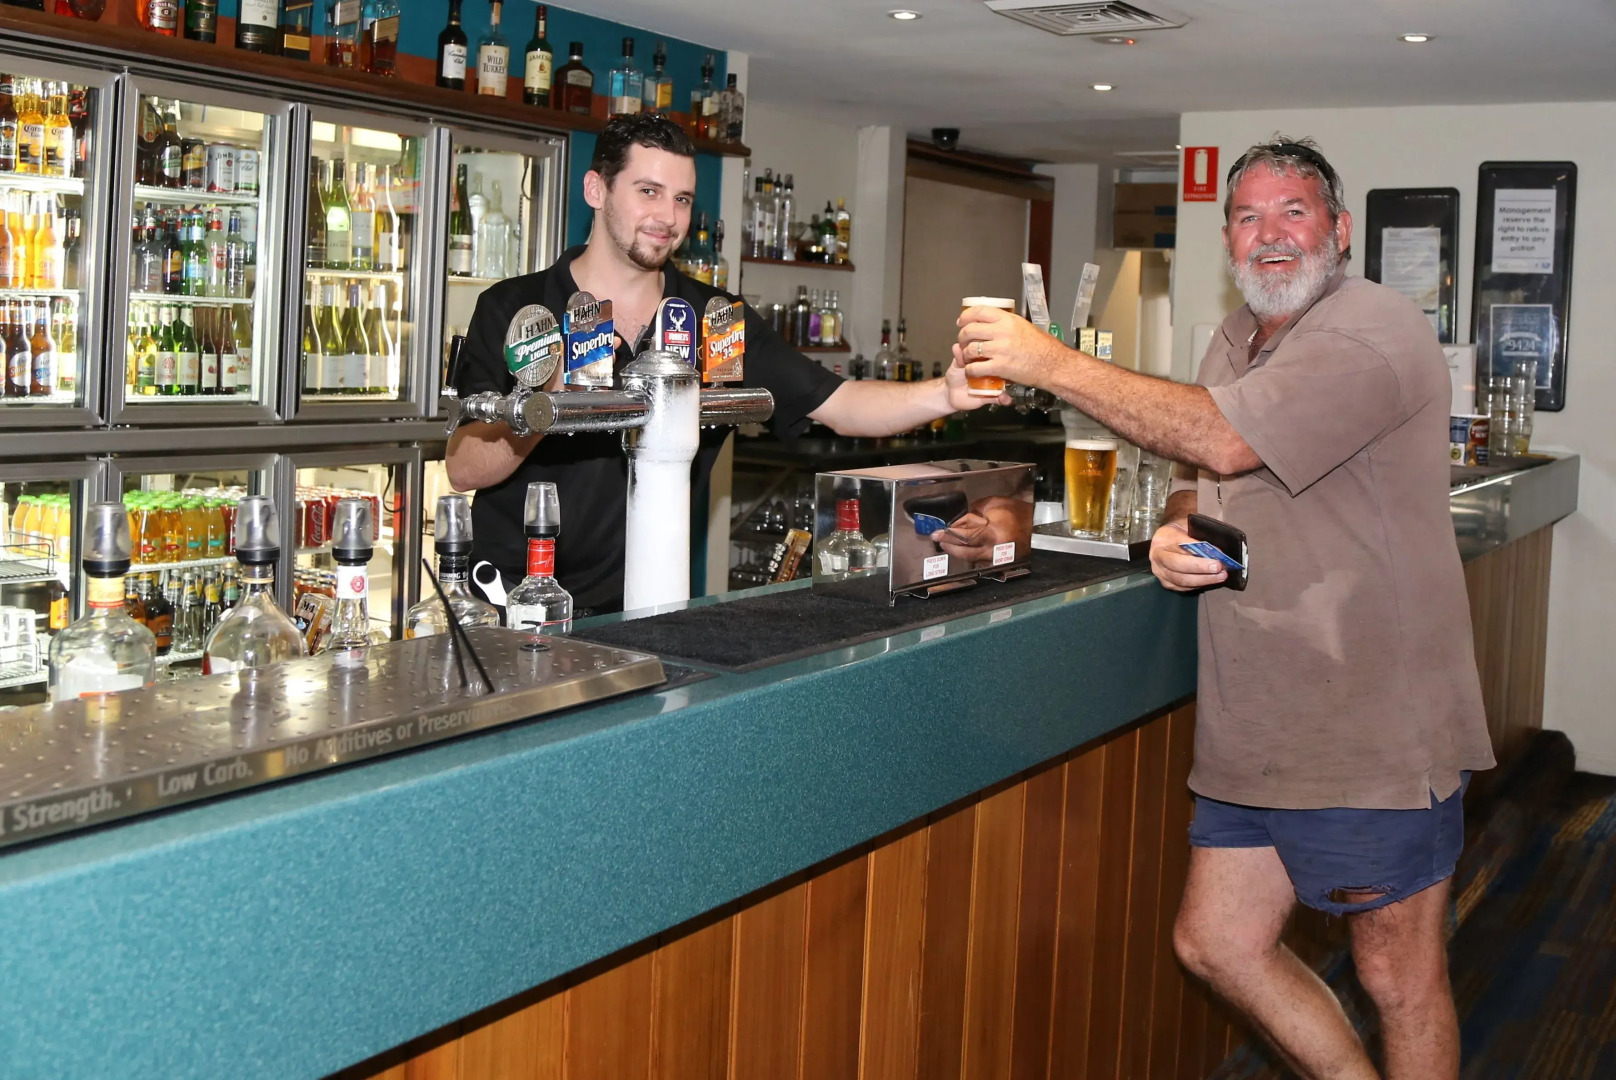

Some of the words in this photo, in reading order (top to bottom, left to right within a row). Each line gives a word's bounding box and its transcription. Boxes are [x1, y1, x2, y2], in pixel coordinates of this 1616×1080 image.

[482, 63, 506, 75] TURKEY
[487, 55, 504, 65] WILD
[1499, 206, 1552, 215] Management
[1498, 225, 1516, 234] right
[1501, 235, 1520, 243] entry
[1522, 234, 1530, 242] to
[1532, 236, 1546, 244] any
[1510, 245, 1536, 253] patron
[573, 301, 600, 322] HAHN
[709, 304, 735, 327] HAHN
[525, 317, 554, 339] HAHN
[516, 332, 561, 363] Premium
[571, 332, 614, 360] SuperDry
[710, 330, 745, 358] SuperDry
[530, 346, 550, 361] LIGHT
[13, 787, 121, 832] Strength.
[158, 772, 197, 797] Low
[203, 756, 253, 786] Carb.
[285, 746, 309, 766] No
[396, 721, 414, 740] or
